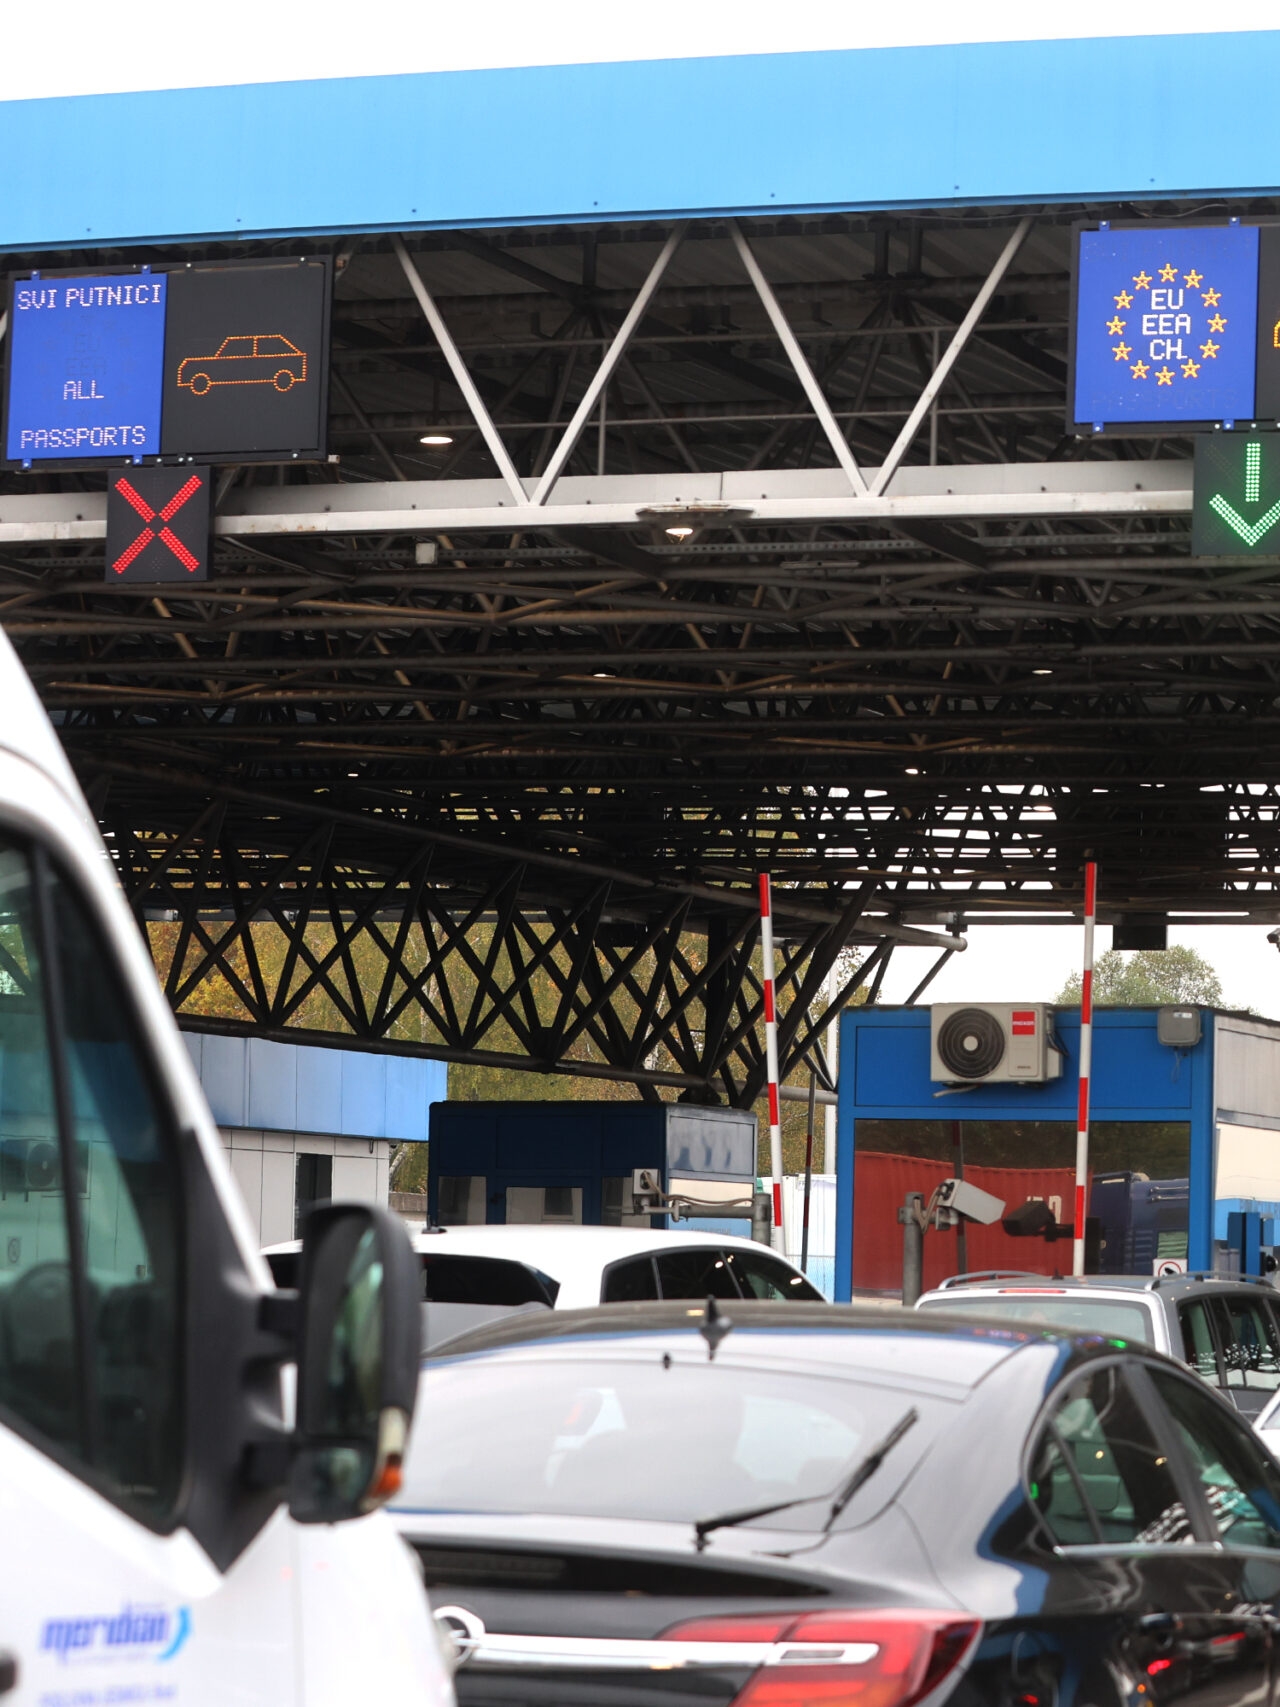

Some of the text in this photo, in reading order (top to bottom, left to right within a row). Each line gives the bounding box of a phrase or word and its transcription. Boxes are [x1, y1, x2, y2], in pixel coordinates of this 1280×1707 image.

[17, 284, 162, 310] SVI PUTNICI
[1150, 288, 1185, 311] EU
[1141, 313, 1192, 336] EEA
[63, 379, 105, 400] ALL
[20, 425, 146, 449] PASSPORTS
